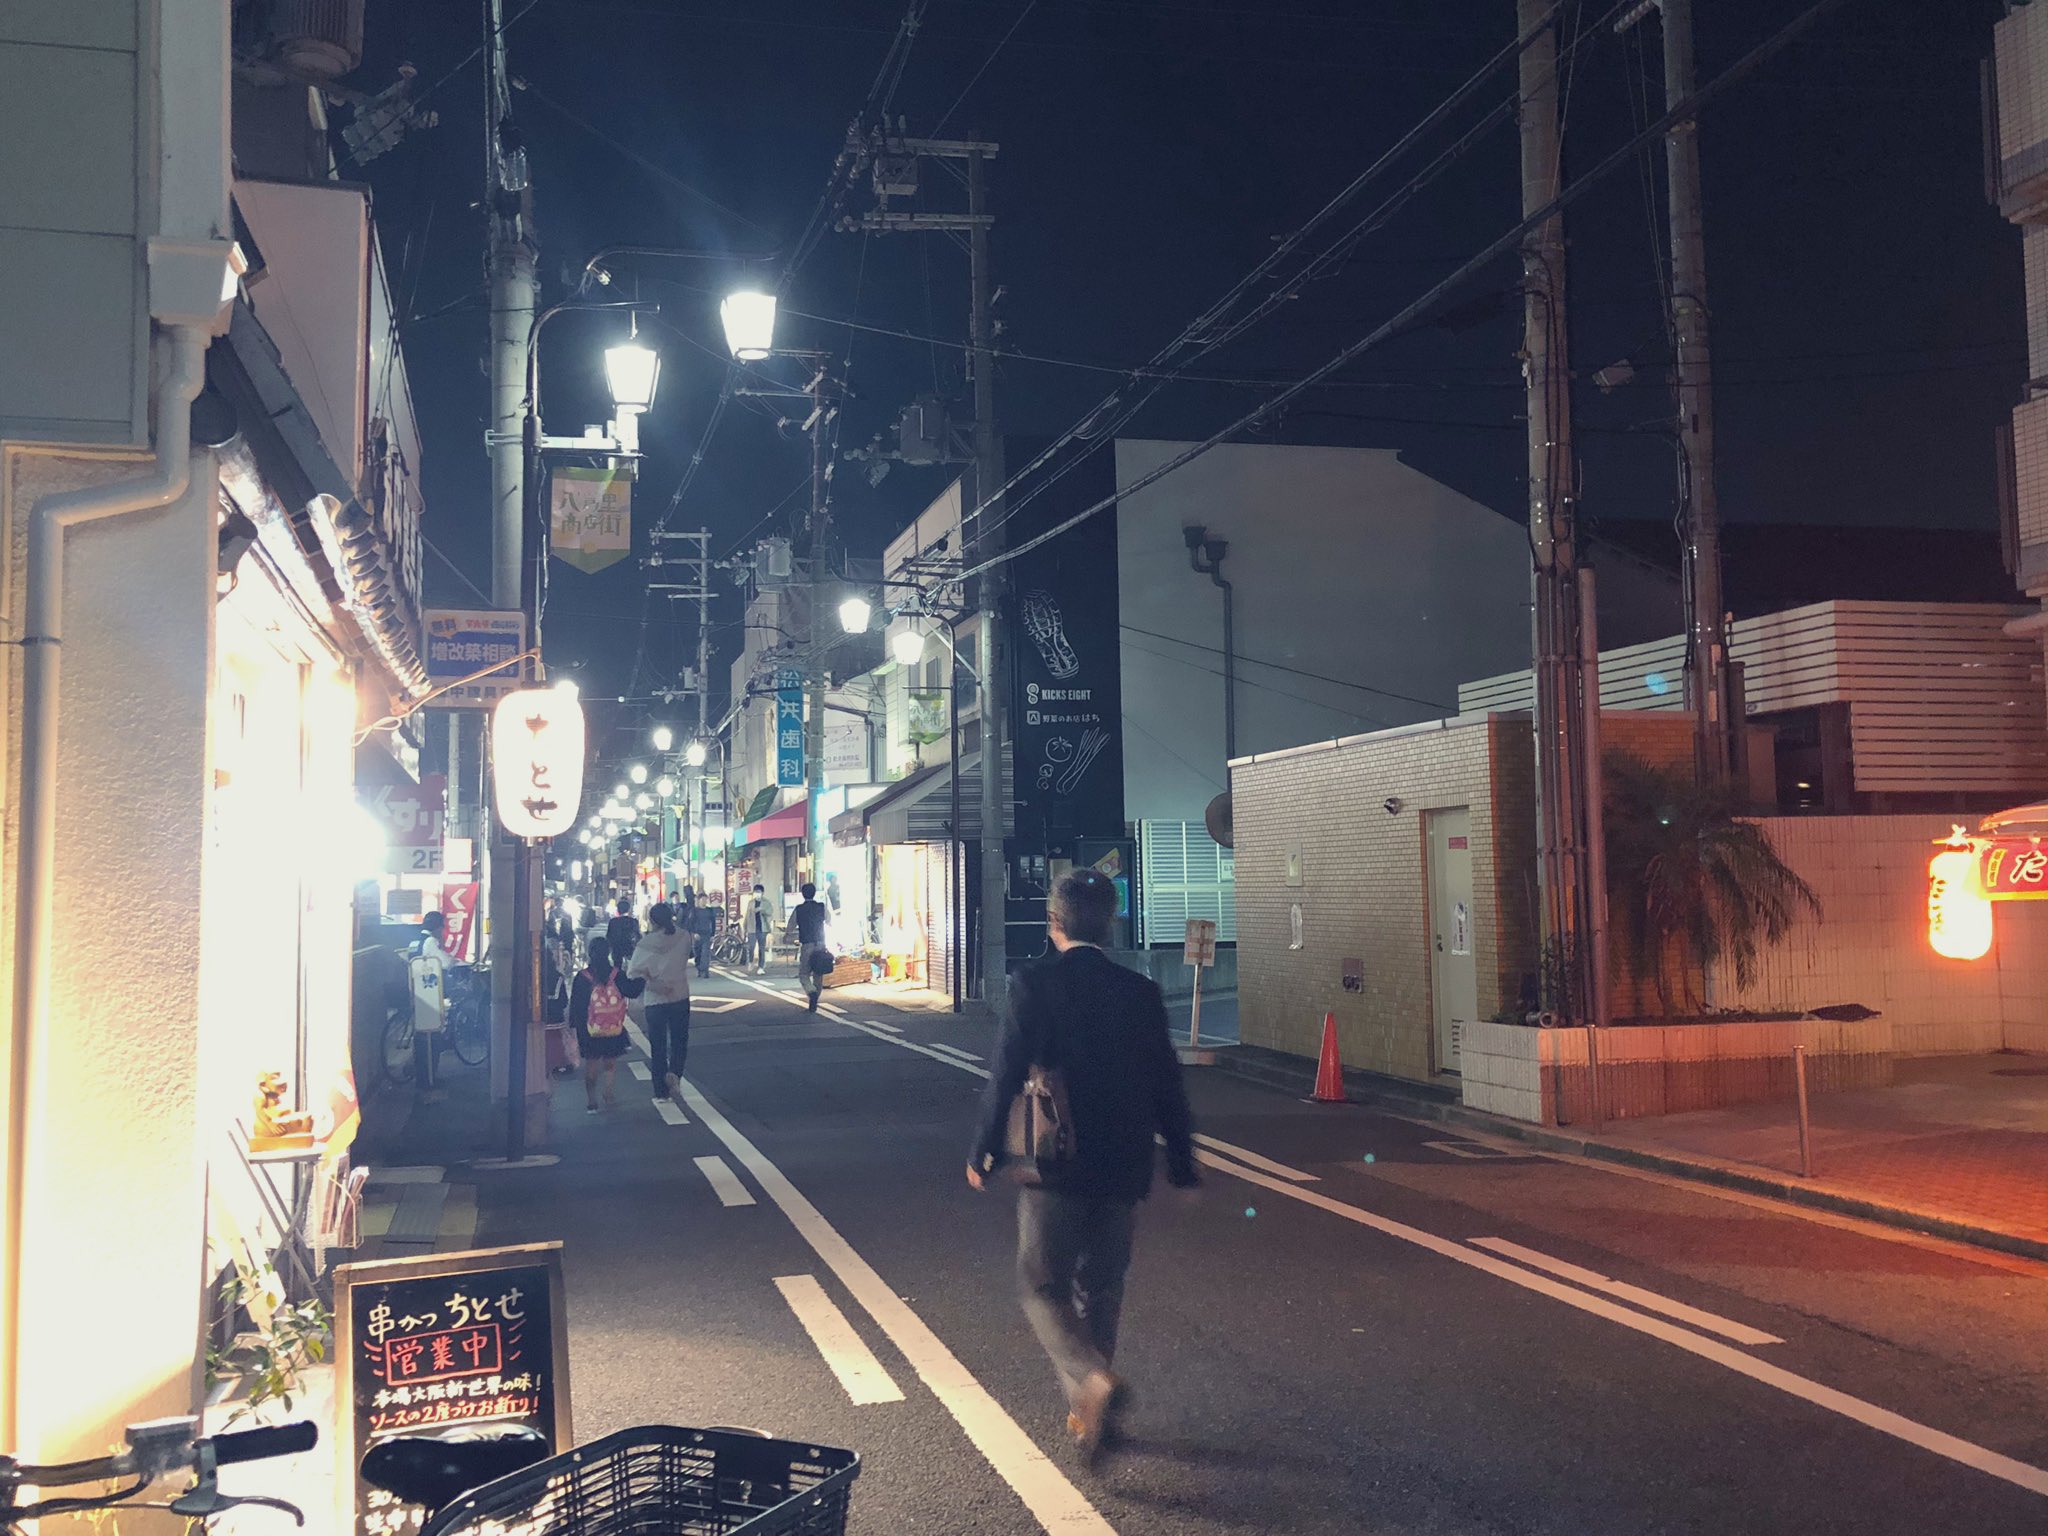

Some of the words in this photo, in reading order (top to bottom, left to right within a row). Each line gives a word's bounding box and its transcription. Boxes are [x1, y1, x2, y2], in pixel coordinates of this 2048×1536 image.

[561, 512, 623, 536] 商店街
[431, 641, 517, 662] 増改築相談
[1041, 689, 1067, 701] KICKS
[1068, 689, 1092, 701] EIGHT
[781, 671, 800, 778] 松井歯科
[375, 784, 443, 841] くすり
[411, 849, 444, 869] 2F
[738, 870, 752, 893] 弁当
[709, 890, 723, 904] 肉
[445, 888, 468, 957] くすり
[368, 1303, 438, 1344] 串かつ
[445, 1288, 525, 1329] ちとせ
[391, 1331, 488, 1375] 営業中
